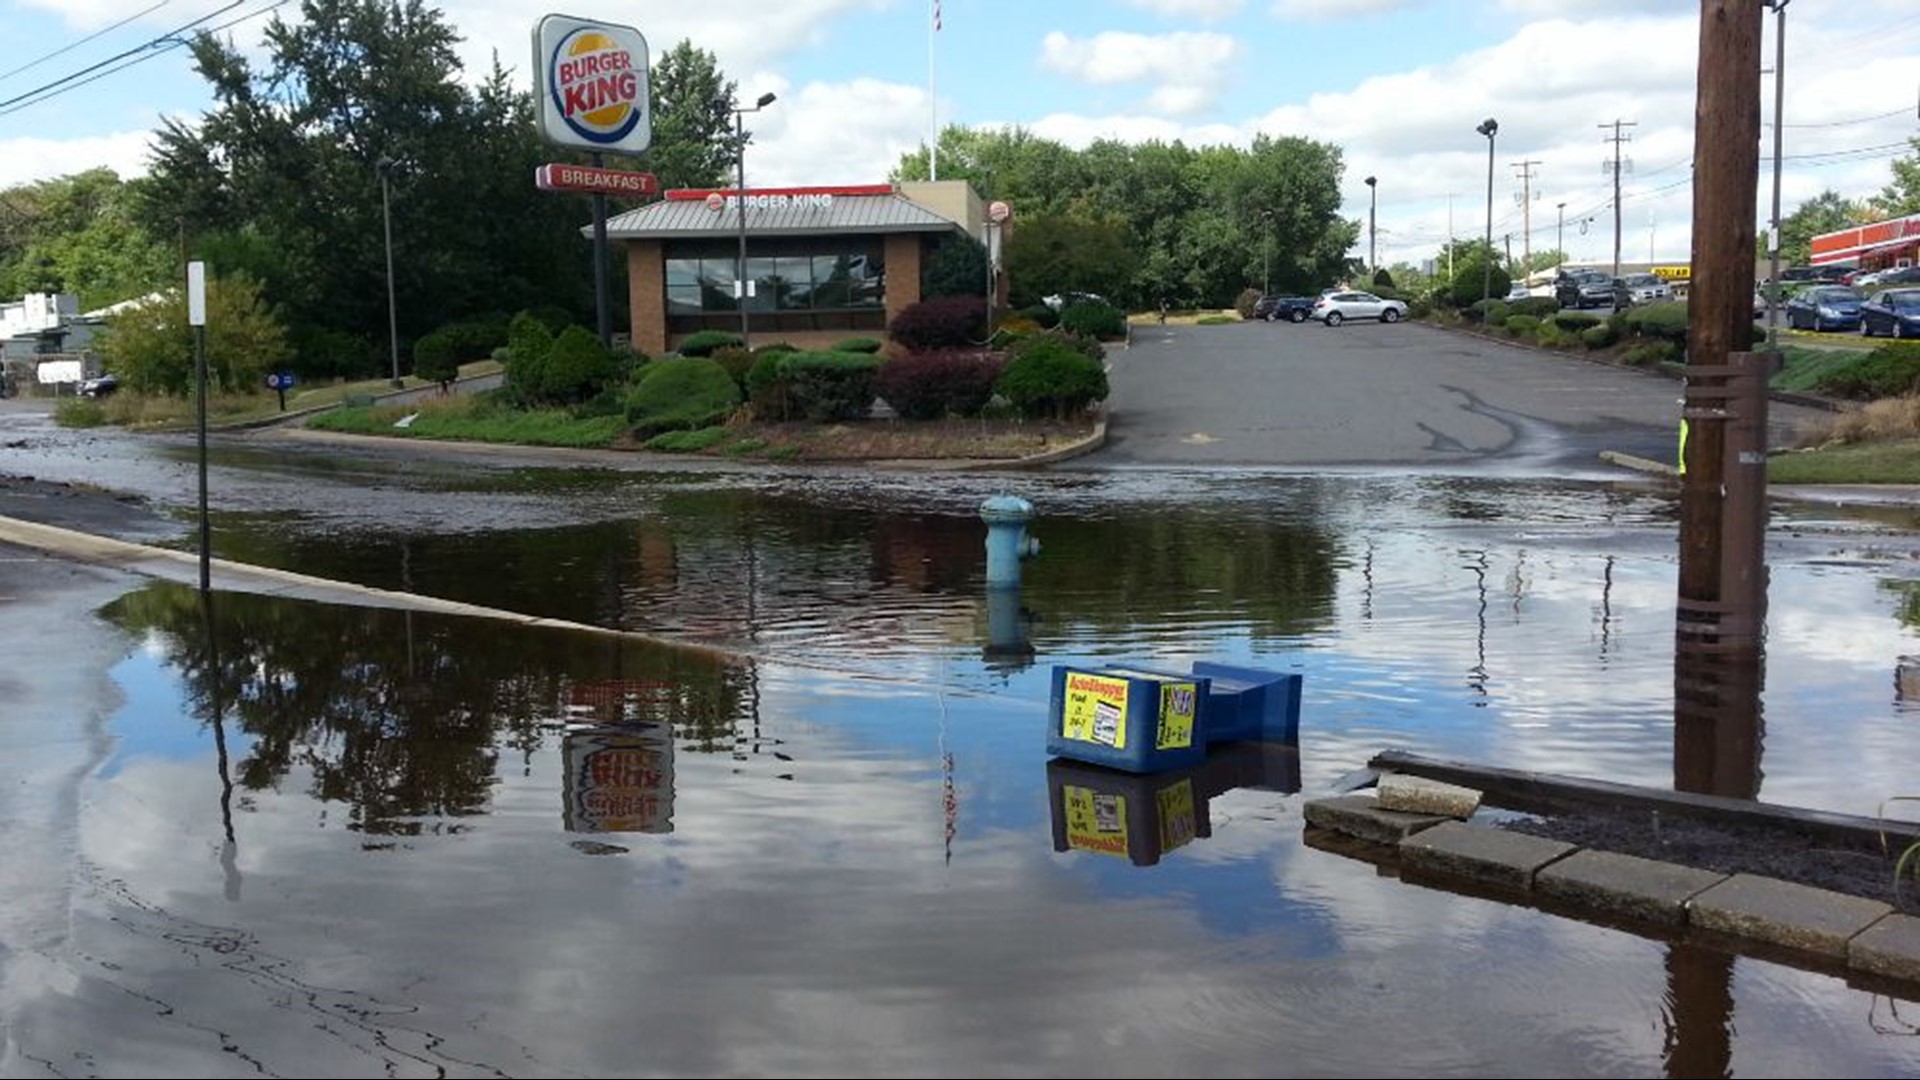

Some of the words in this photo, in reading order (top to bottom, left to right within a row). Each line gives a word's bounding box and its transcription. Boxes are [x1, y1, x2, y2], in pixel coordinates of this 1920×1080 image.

[559, 50, 632, 85] BURGER
[563, 72, 637, 119] KING
[561, 168, 647, 190] BREAKFAST
[727, 193, 789, 208] BURGER
[792, 193, 832, 207] KING
